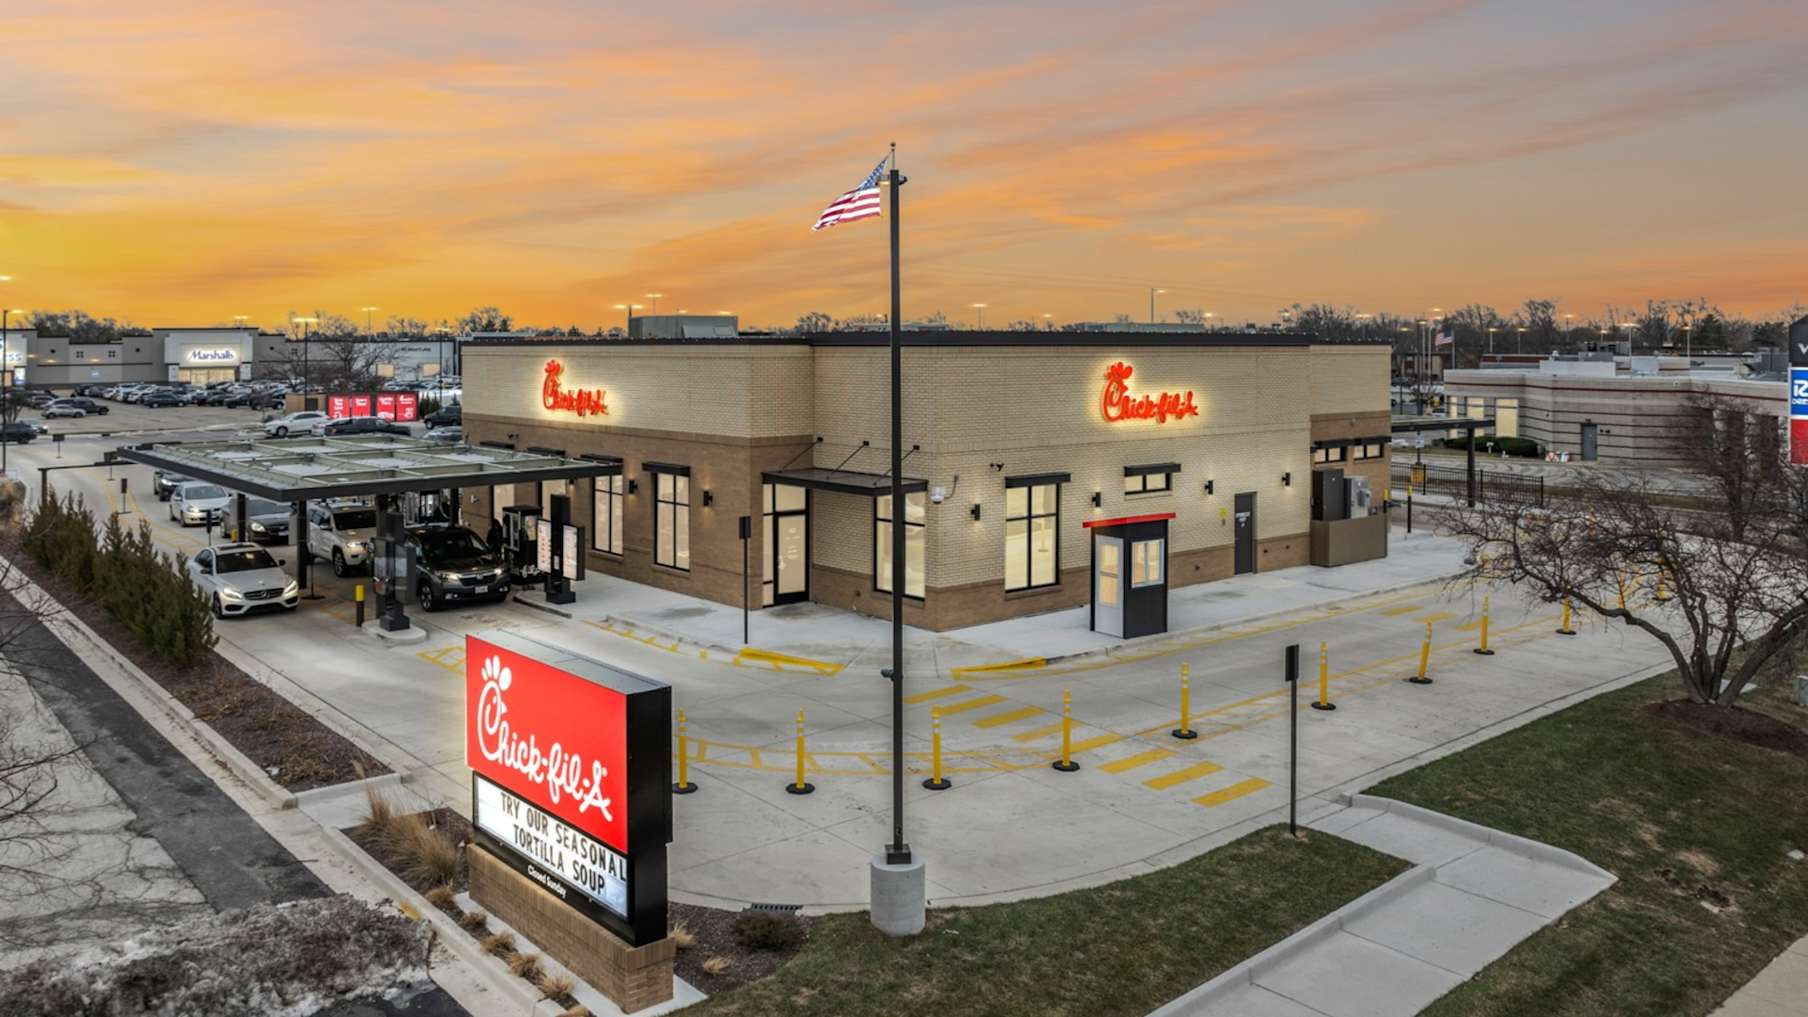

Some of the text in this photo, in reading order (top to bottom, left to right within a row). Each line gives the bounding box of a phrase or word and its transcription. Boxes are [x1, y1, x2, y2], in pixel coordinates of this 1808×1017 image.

[191, 349, 234, 361] Marshalls
[1103, 372, 1200, 424] Chick-fil-A
[477, 675, 613, 822] Chick-fil-A
[500, 792, 627, 882] TRY OUR SEASONAL
[527, 864, 567, 899] Closed Sunday
[572, 860, 605, 896] SOUP
